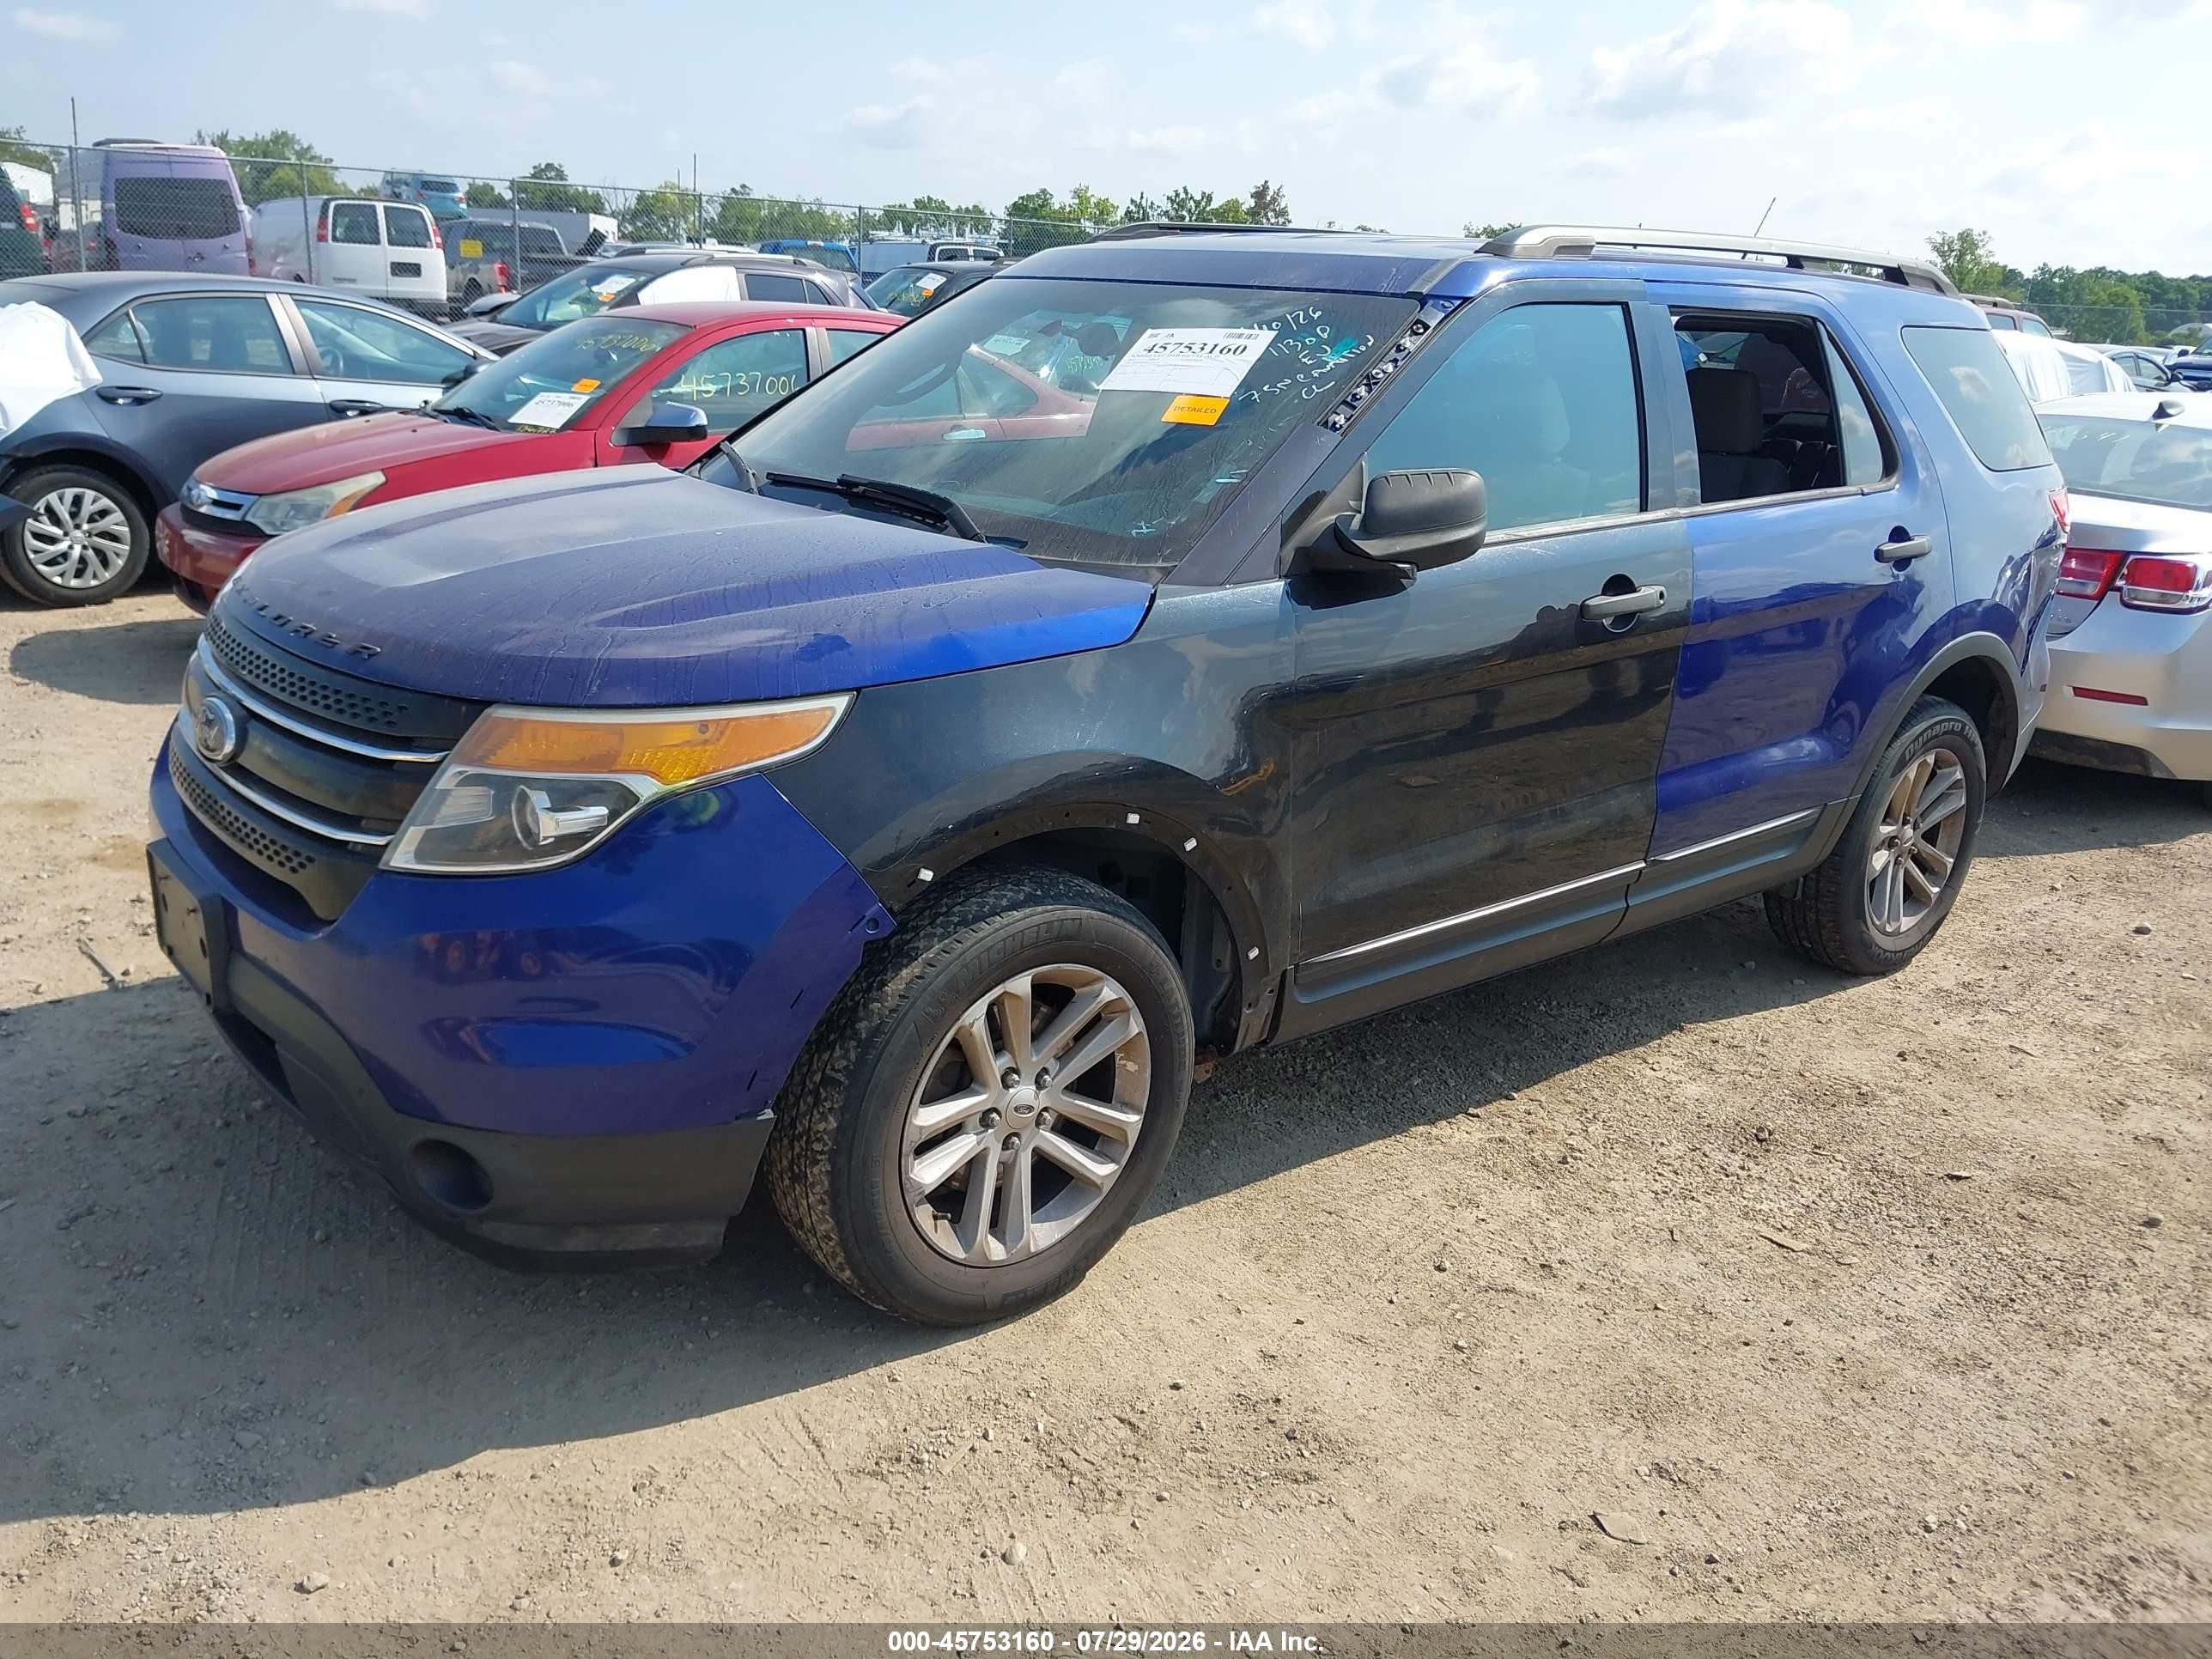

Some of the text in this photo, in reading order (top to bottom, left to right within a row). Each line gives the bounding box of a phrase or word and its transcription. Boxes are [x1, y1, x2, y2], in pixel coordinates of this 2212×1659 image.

[1142, 342, 1249, 357] 45753160
[1172, 405, 1218, 415] DETAILED
[968, 917, 1084, 980] MICHELIN
